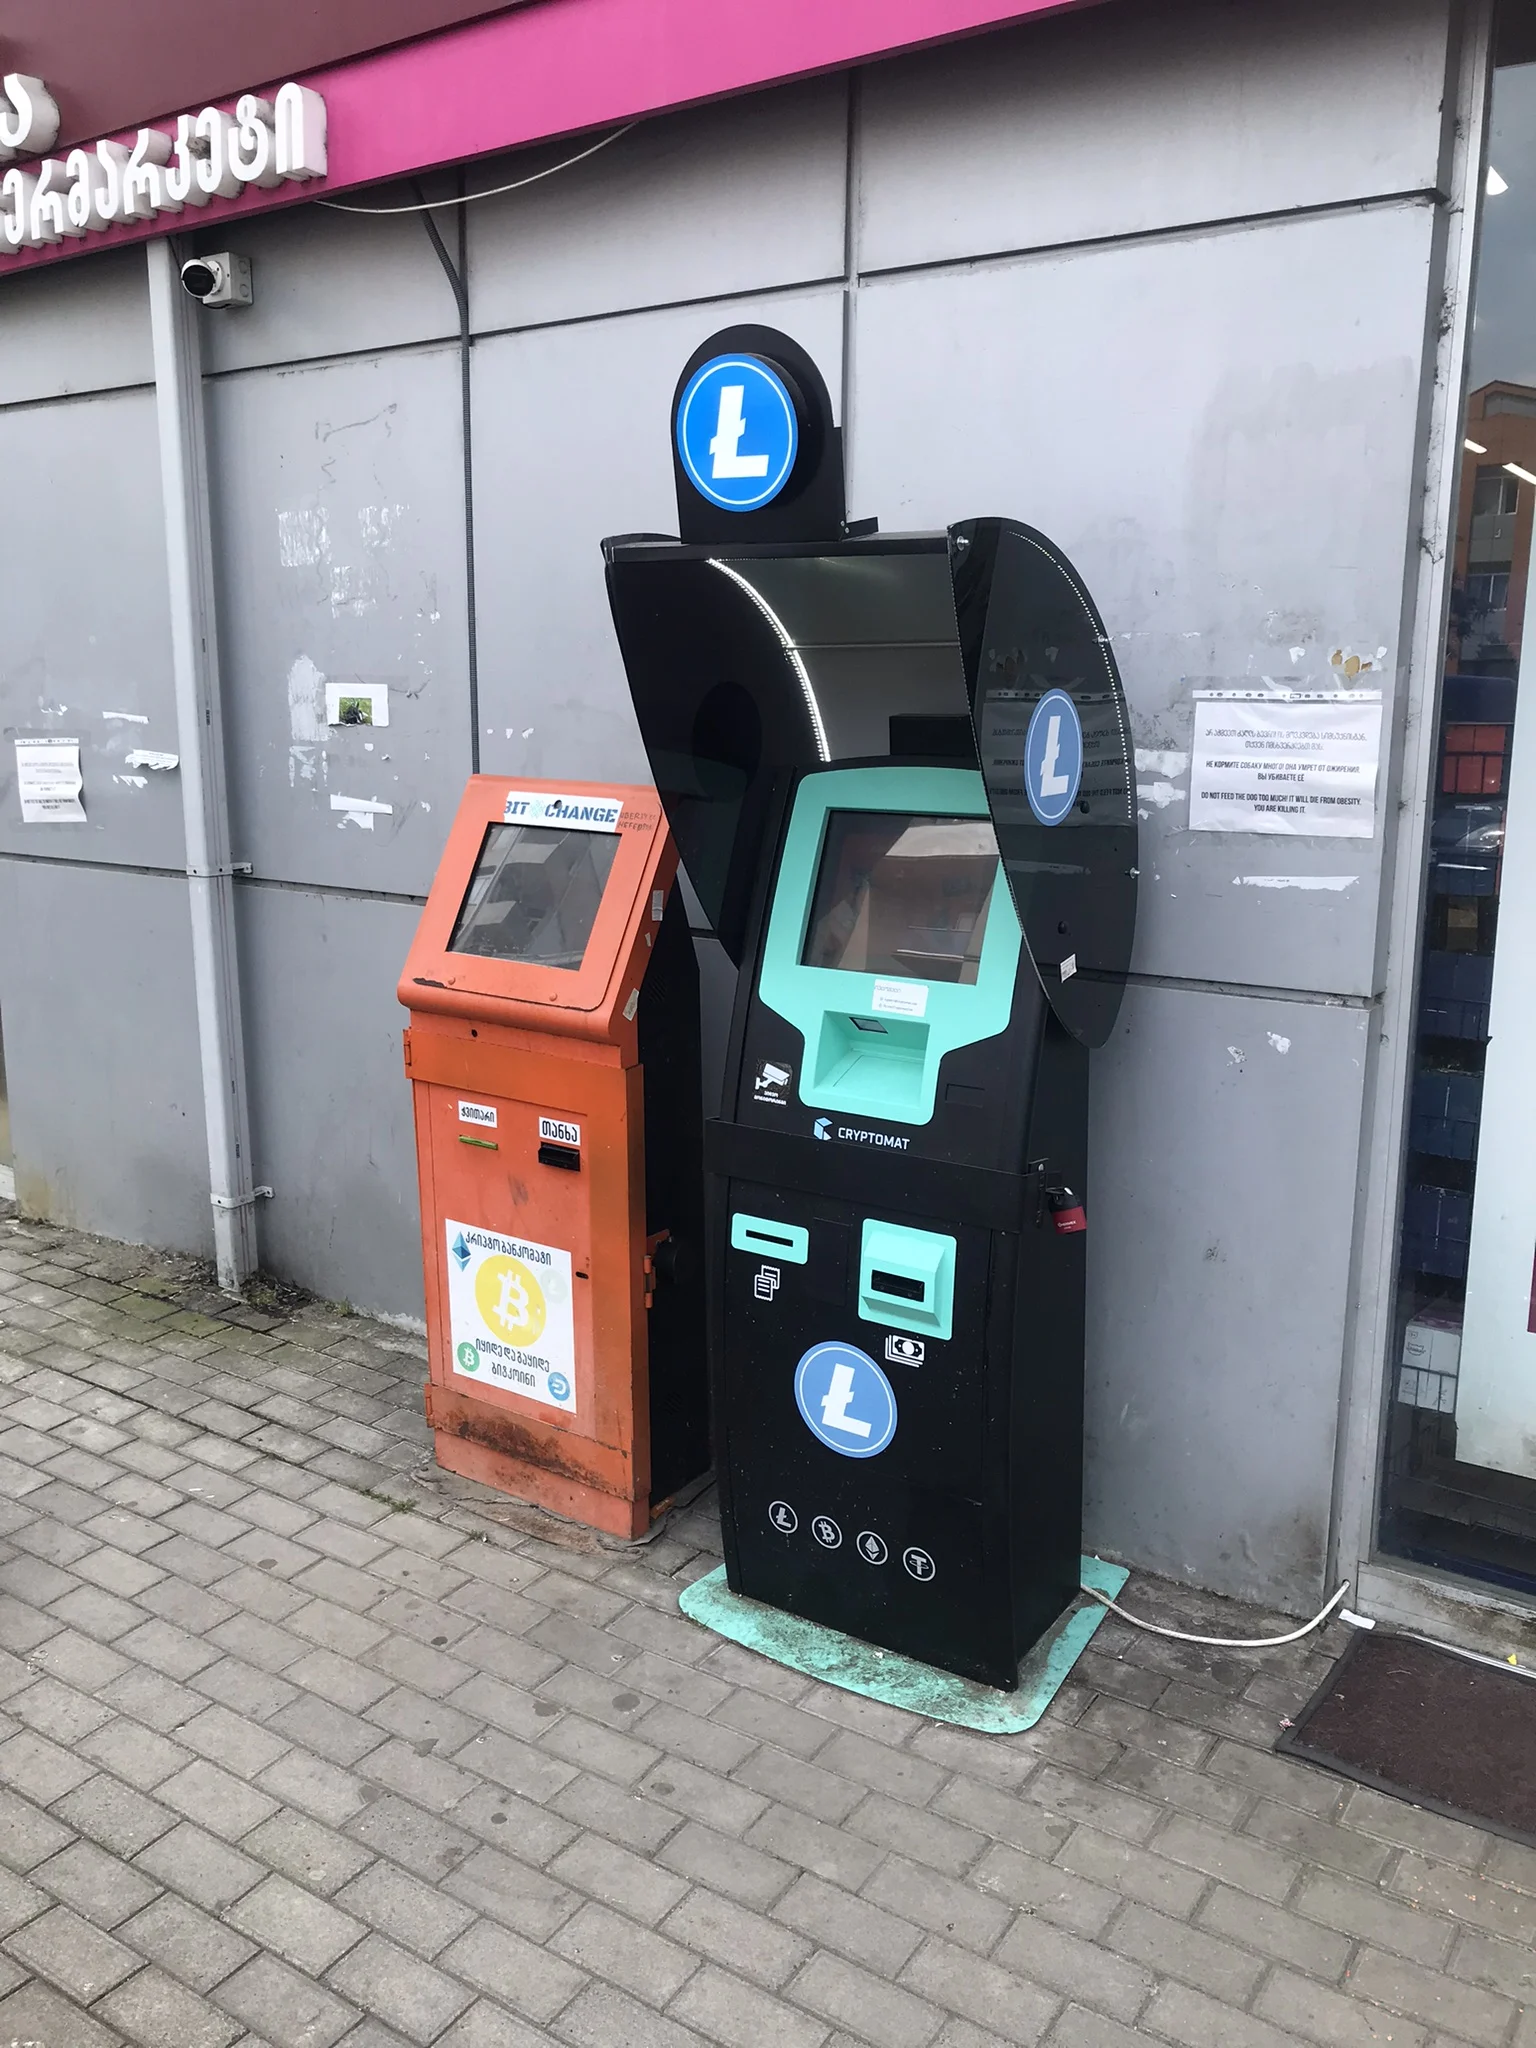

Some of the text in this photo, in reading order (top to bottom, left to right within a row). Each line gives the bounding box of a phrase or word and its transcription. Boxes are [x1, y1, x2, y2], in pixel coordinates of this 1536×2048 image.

[1206, 760, 1213, 768] НЕ
[1214, 761, 1239, 769] КОРМИТЕ
[1240, 761, 1262, 769] СОБАКУ
[1318, 764, 1326, 772] ОТ
[1268, 773, 1296, 781] УБИВАЕТЕ
[544, 801, 619, 823] CHANGE
[541, 1120, 578, 1143] თანხა
[838, 1127, 910, 1150] CRYPTOMAT
